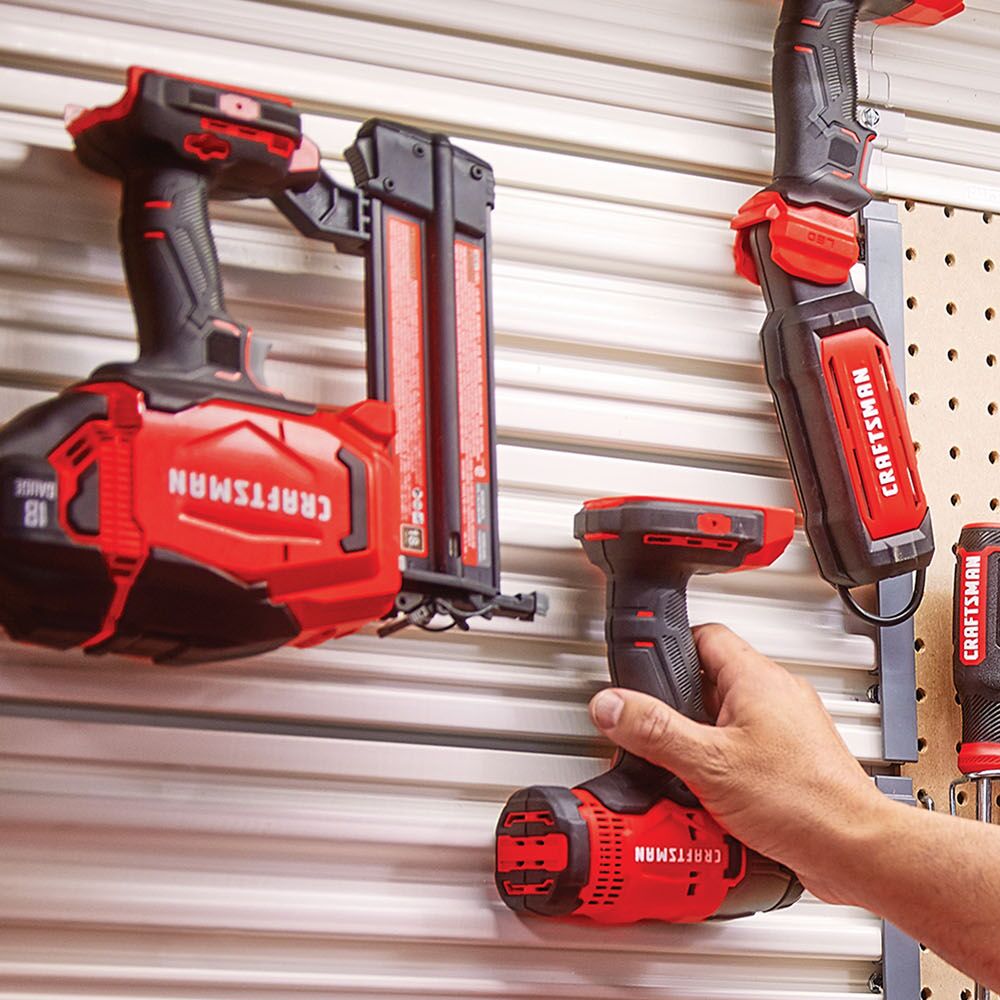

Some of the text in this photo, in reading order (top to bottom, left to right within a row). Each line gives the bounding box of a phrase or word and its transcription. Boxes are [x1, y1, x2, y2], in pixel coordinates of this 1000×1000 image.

[853, 366, 899, 497] CRAFTSMAN
[168, 467, 334, 521] CRAFTSMAN
[963, 554, 981, 661] CRAFTSMAN
[634, 846, 721, 863] CRAFTSMAN
